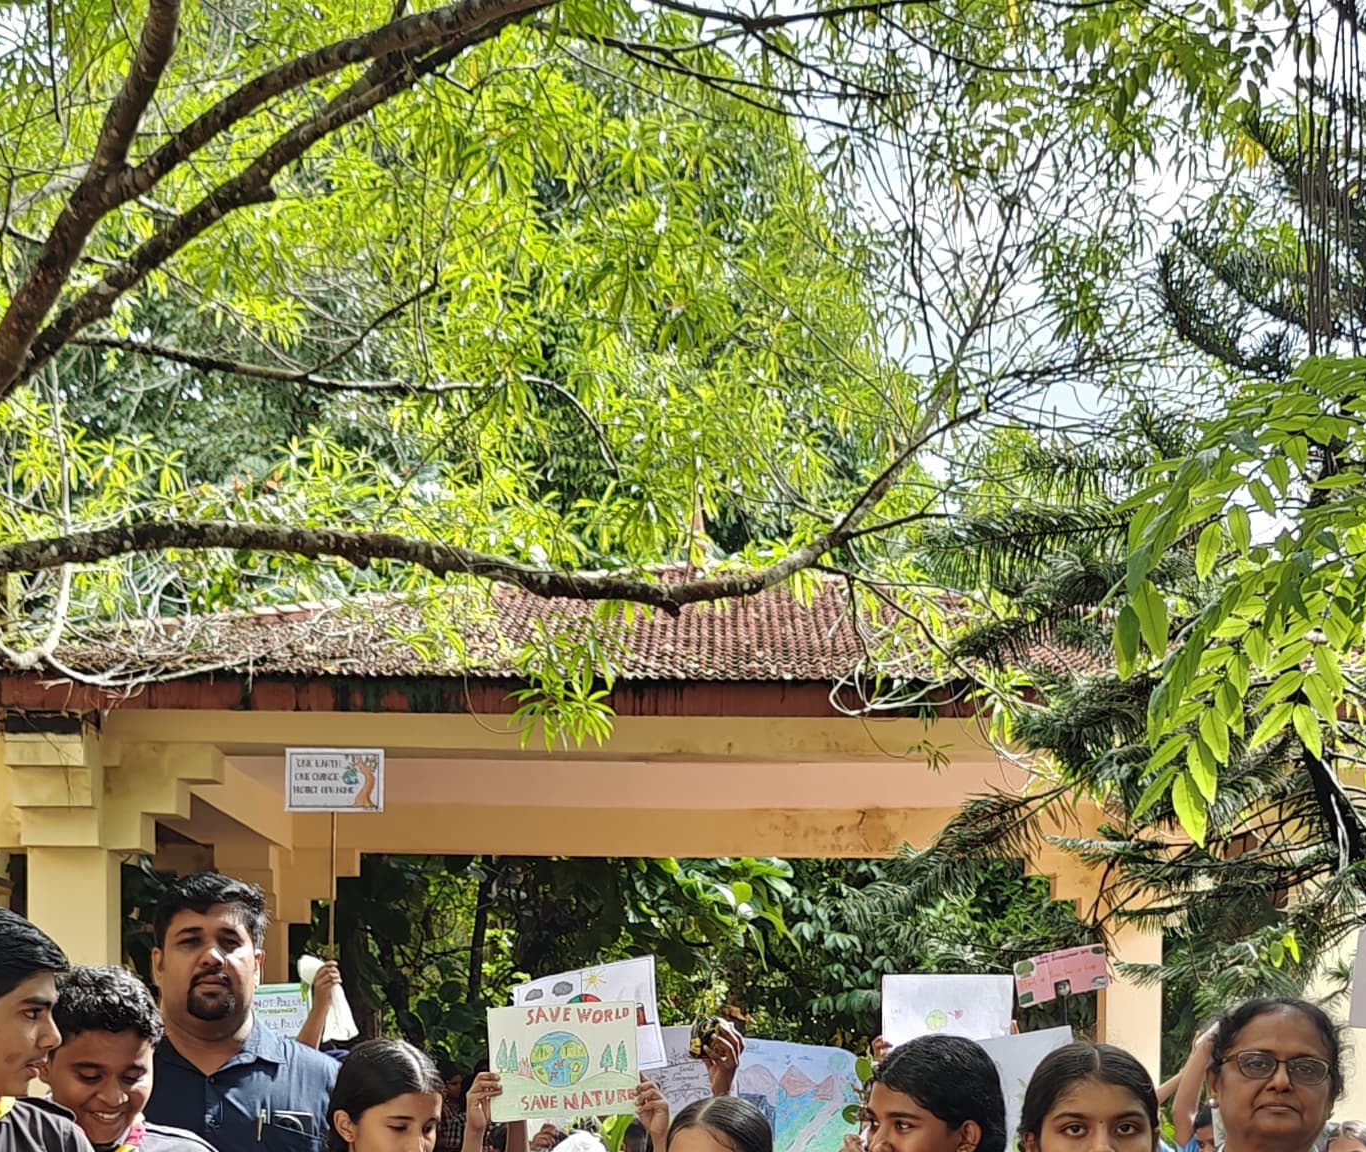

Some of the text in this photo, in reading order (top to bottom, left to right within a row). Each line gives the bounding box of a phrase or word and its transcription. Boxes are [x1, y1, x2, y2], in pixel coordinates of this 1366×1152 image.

[526, 1006, 630, 1025] SAVE WORLD
[521, 1088, 635, 1111] SAVE NATURE
